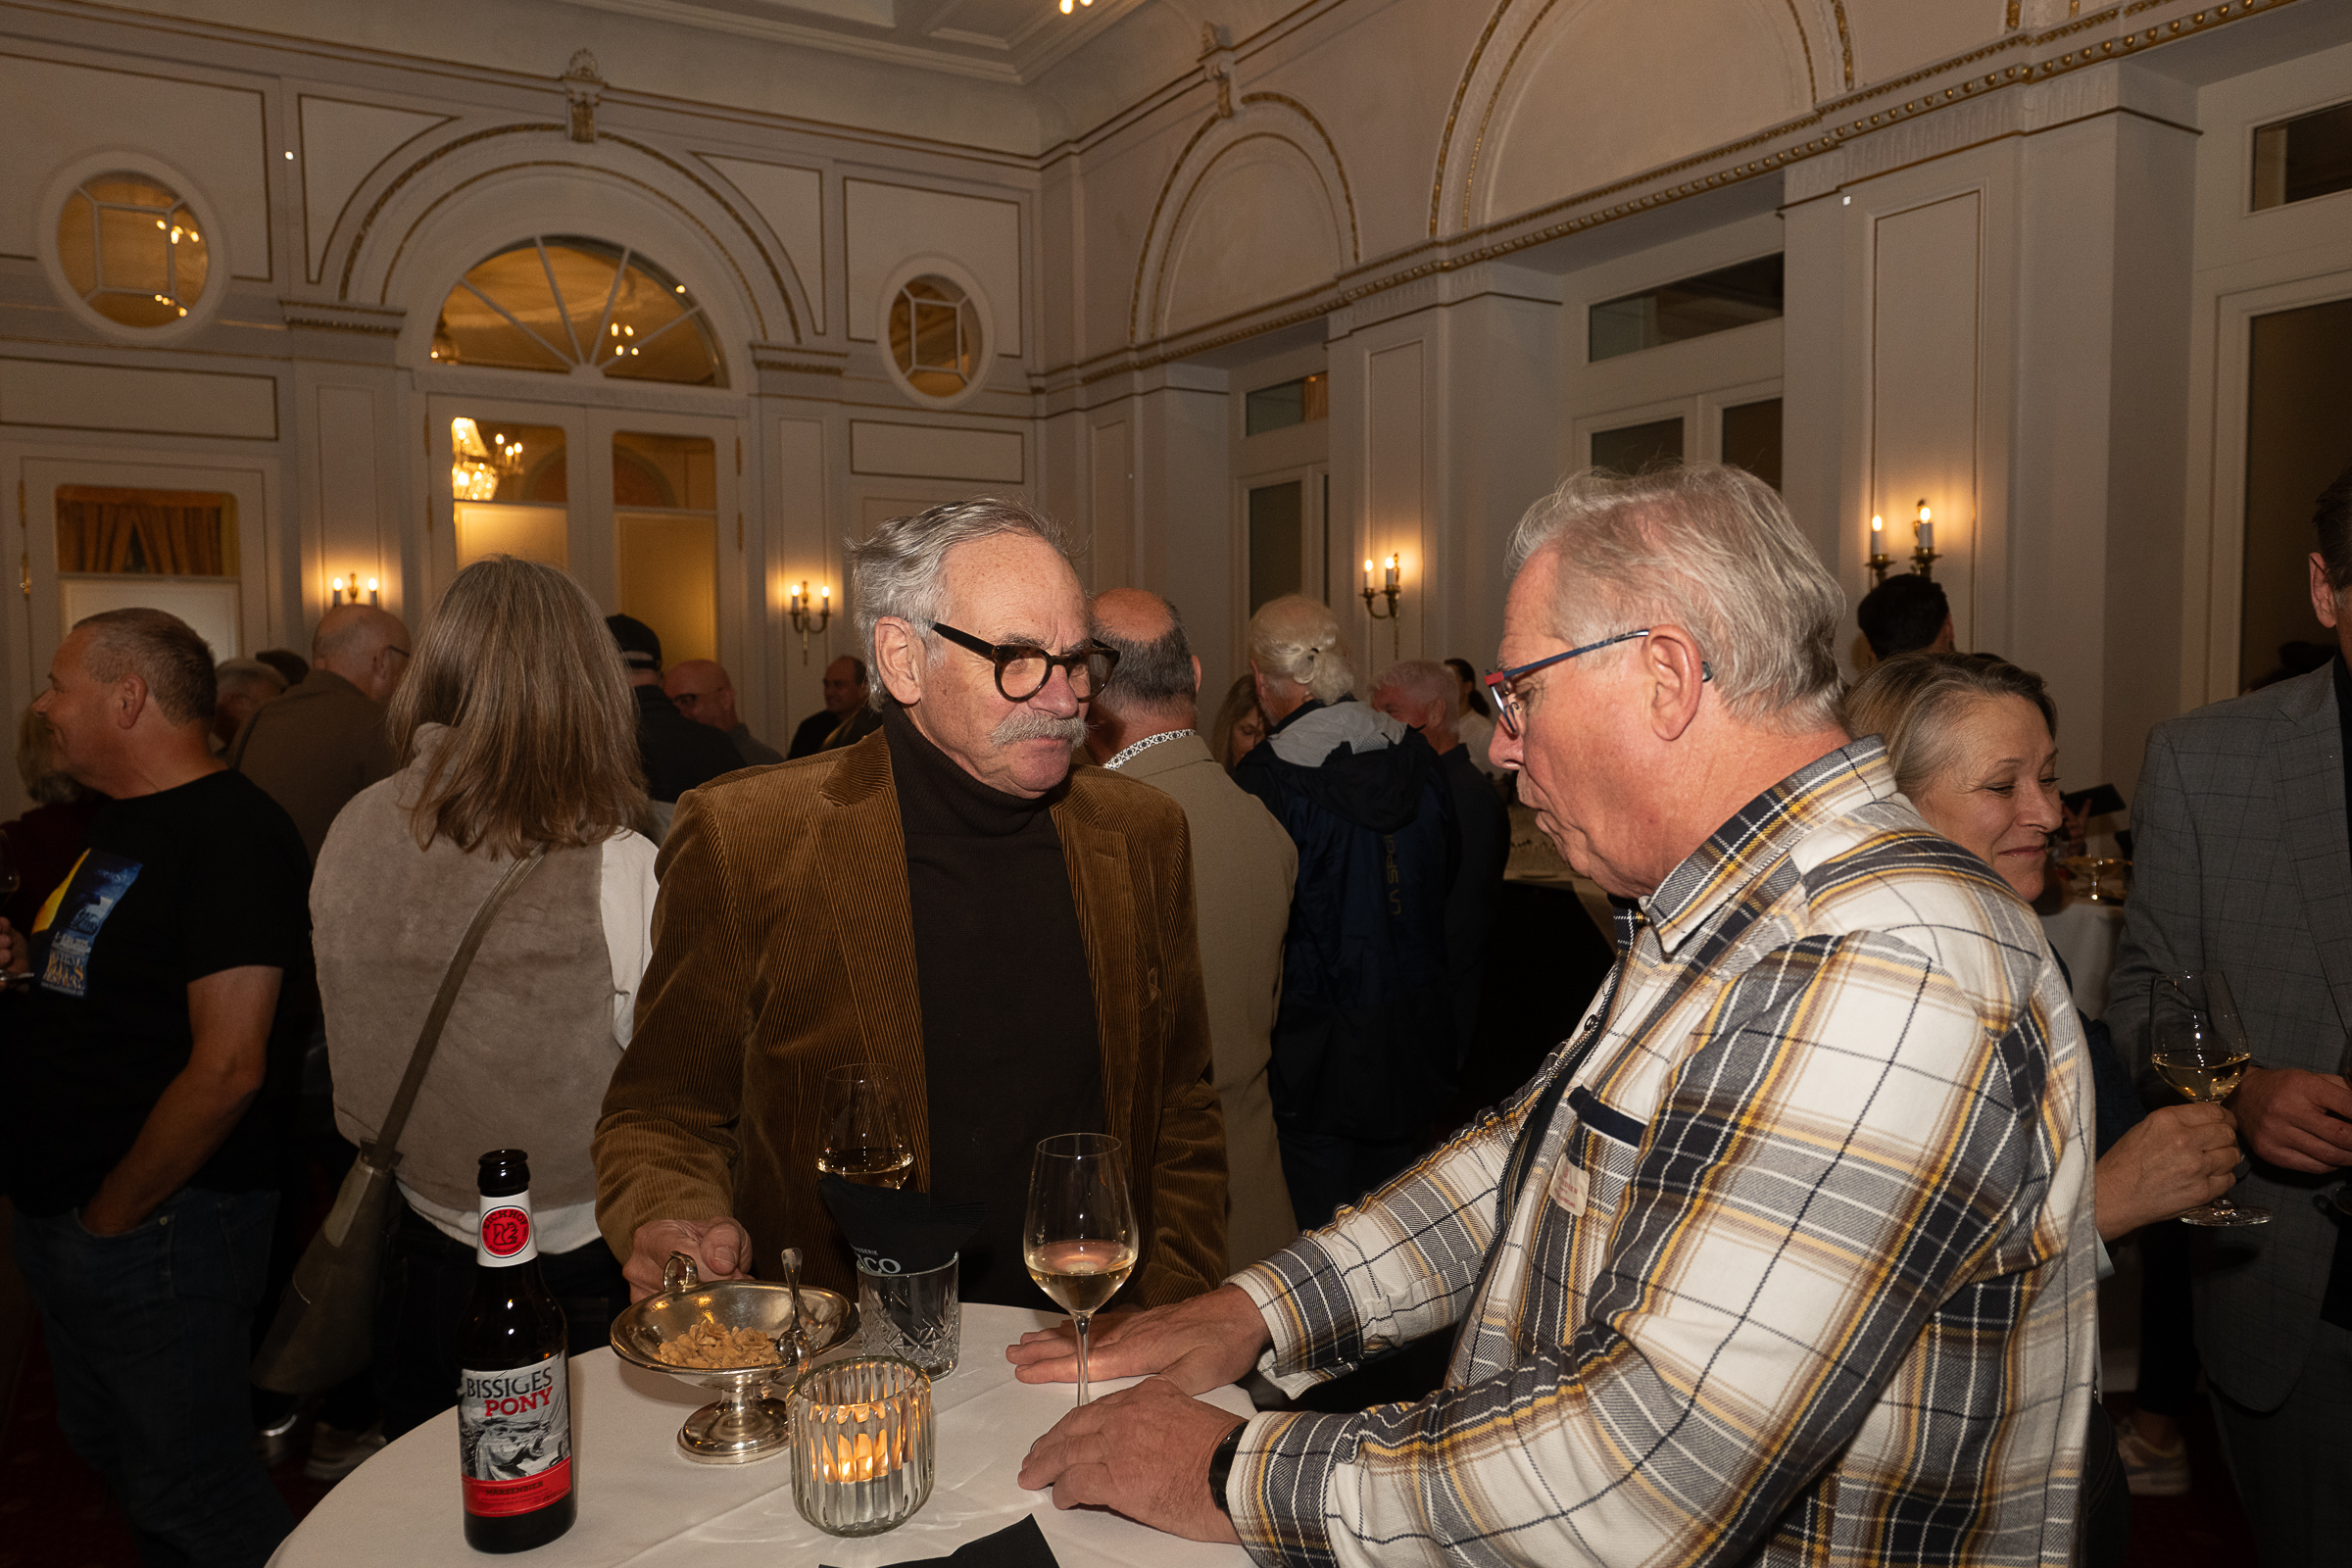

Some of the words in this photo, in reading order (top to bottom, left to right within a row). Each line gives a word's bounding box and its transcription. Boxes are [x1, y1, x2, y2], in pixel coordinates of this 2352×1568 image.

[483, 1210, 527, 1231] EICHHOF
[466, 1367, 553, 1398] BISSIGES
[484, 1386, 553, 1417] PONY
